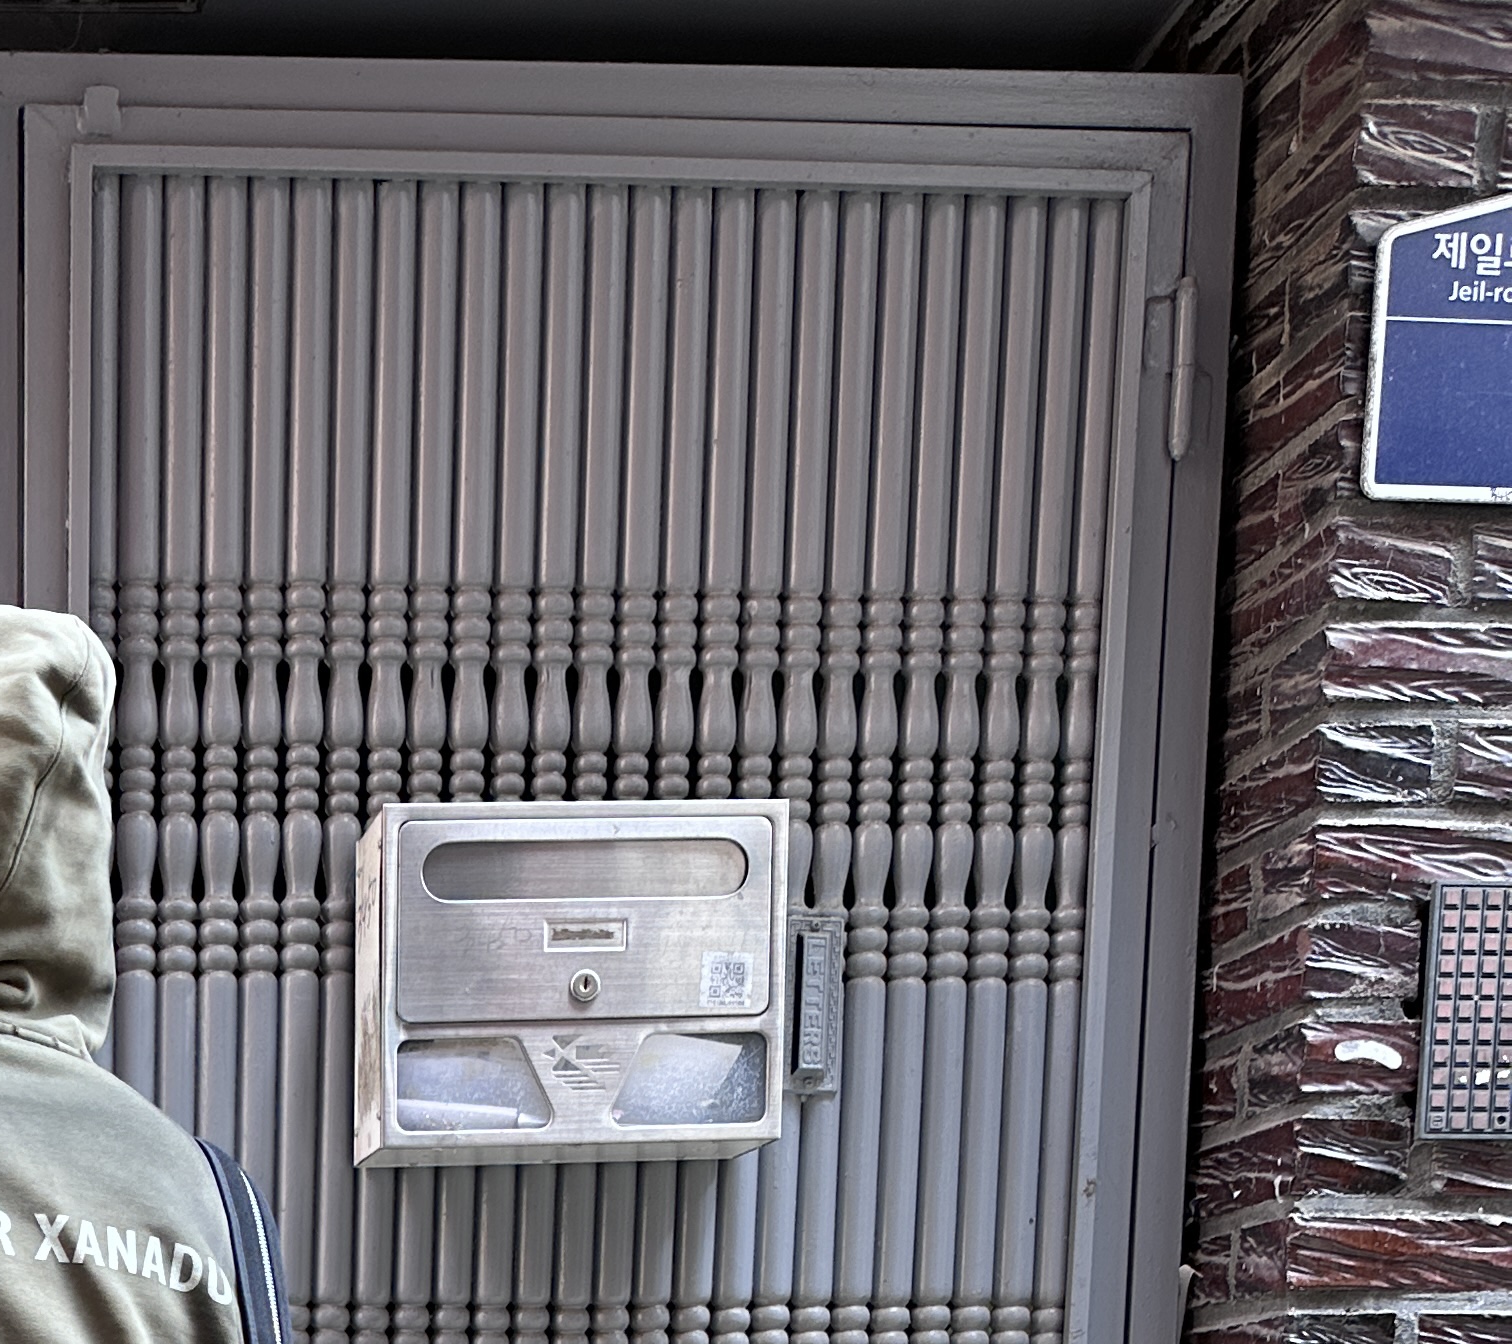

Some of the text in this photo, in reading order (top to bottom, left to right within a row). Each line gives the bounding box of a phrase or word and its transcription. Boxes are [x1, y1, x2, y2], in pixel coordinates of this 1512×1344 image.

[1432, 231, 1512, 276] 제일
[803, 936, 828, 1066] LETTERS
[34, 1212, 233, 1306] XANADU
